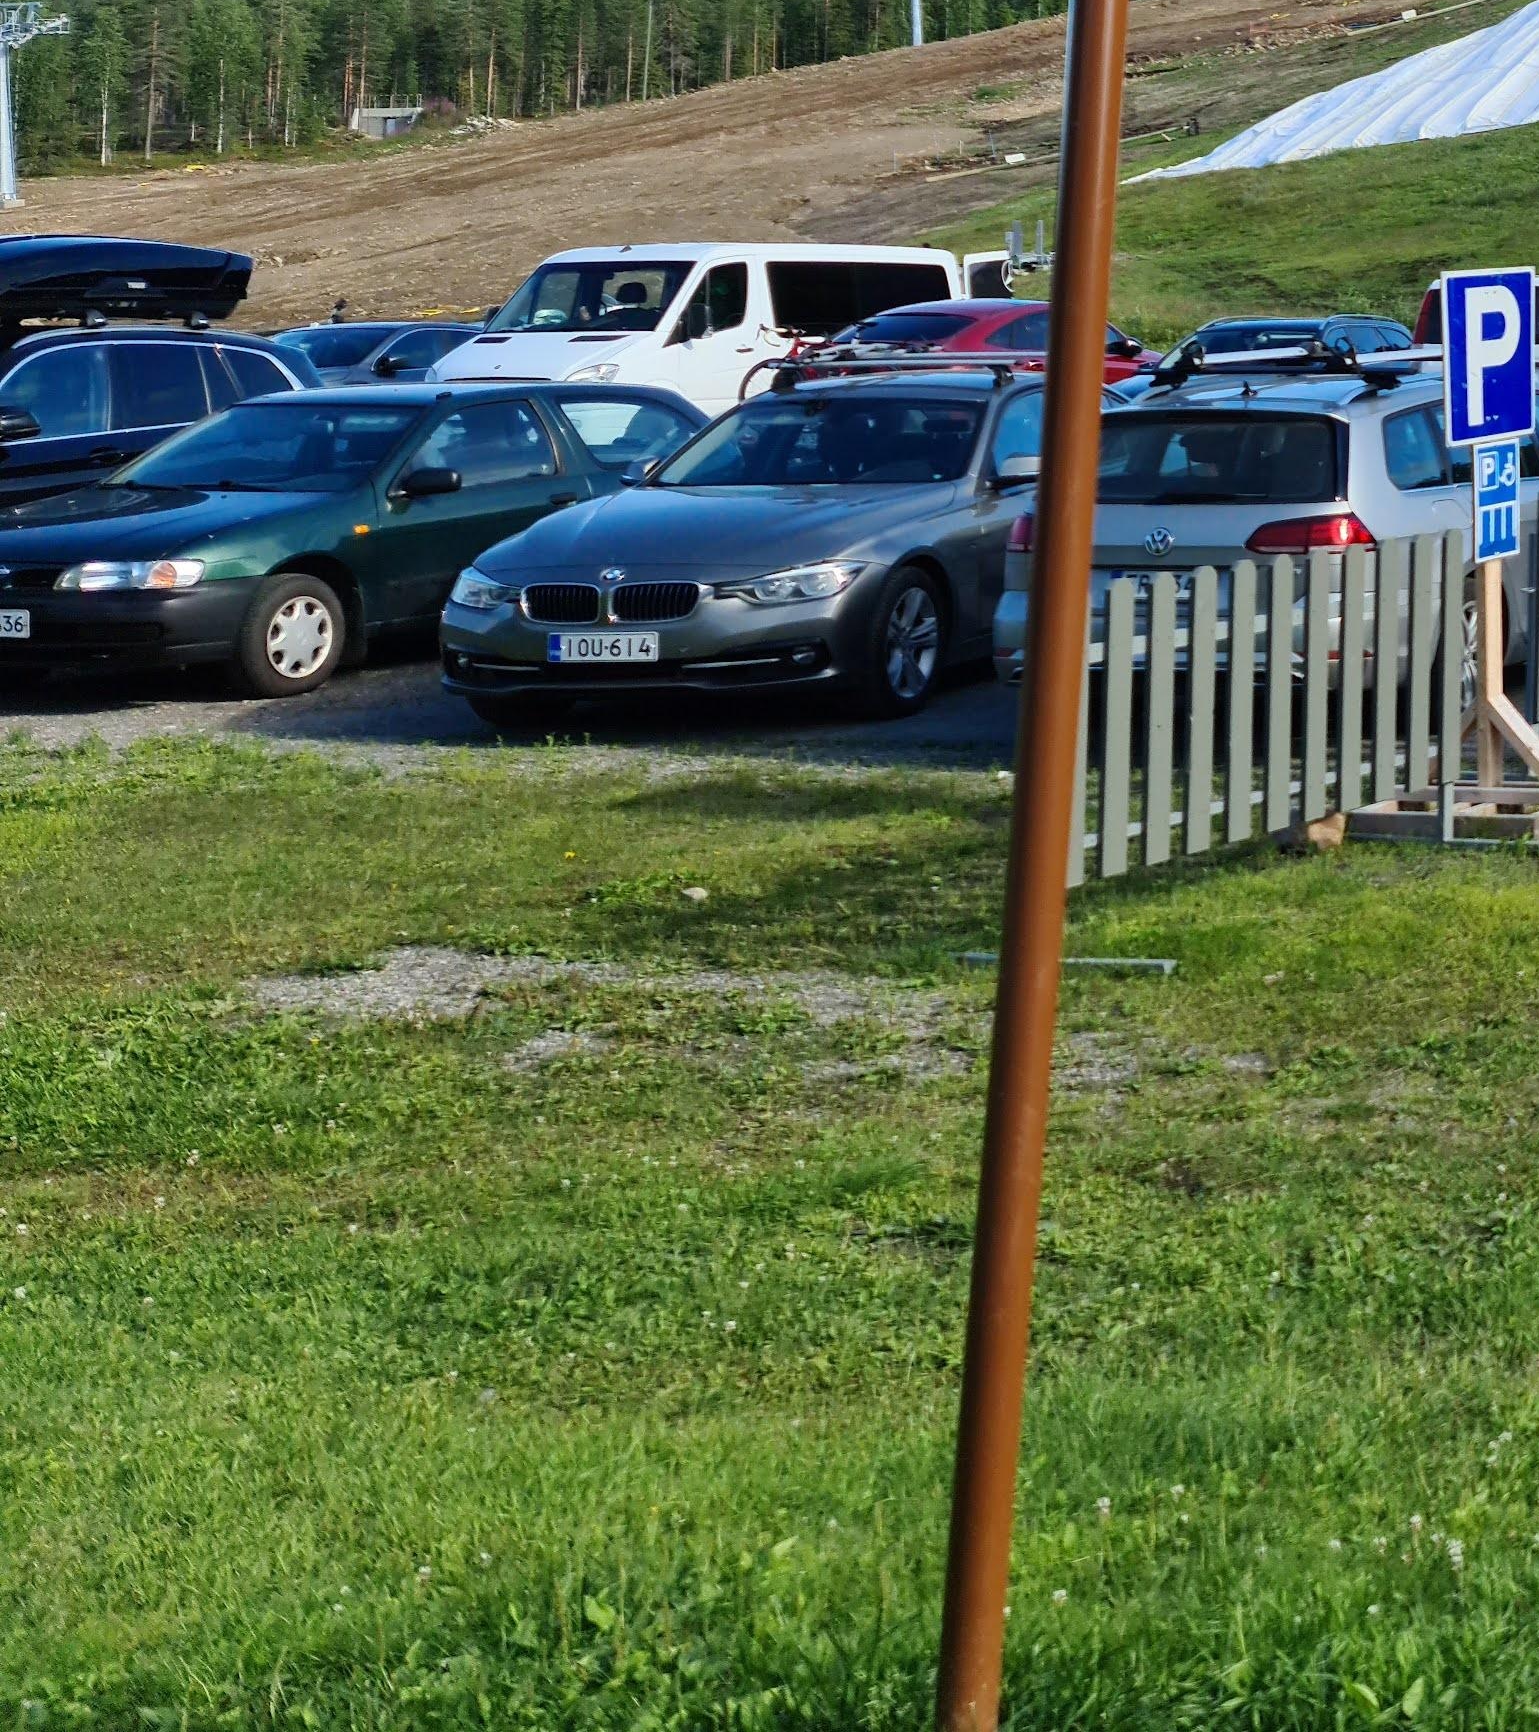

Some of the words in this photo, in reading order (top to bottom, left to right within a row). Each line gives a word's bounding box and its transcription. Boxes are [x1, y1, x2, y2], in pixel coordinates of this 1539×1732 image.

[1465, 285, 1521, 427] P
[1482, 459, 1495, 486] P
[0, 615, 24, 633] 36
